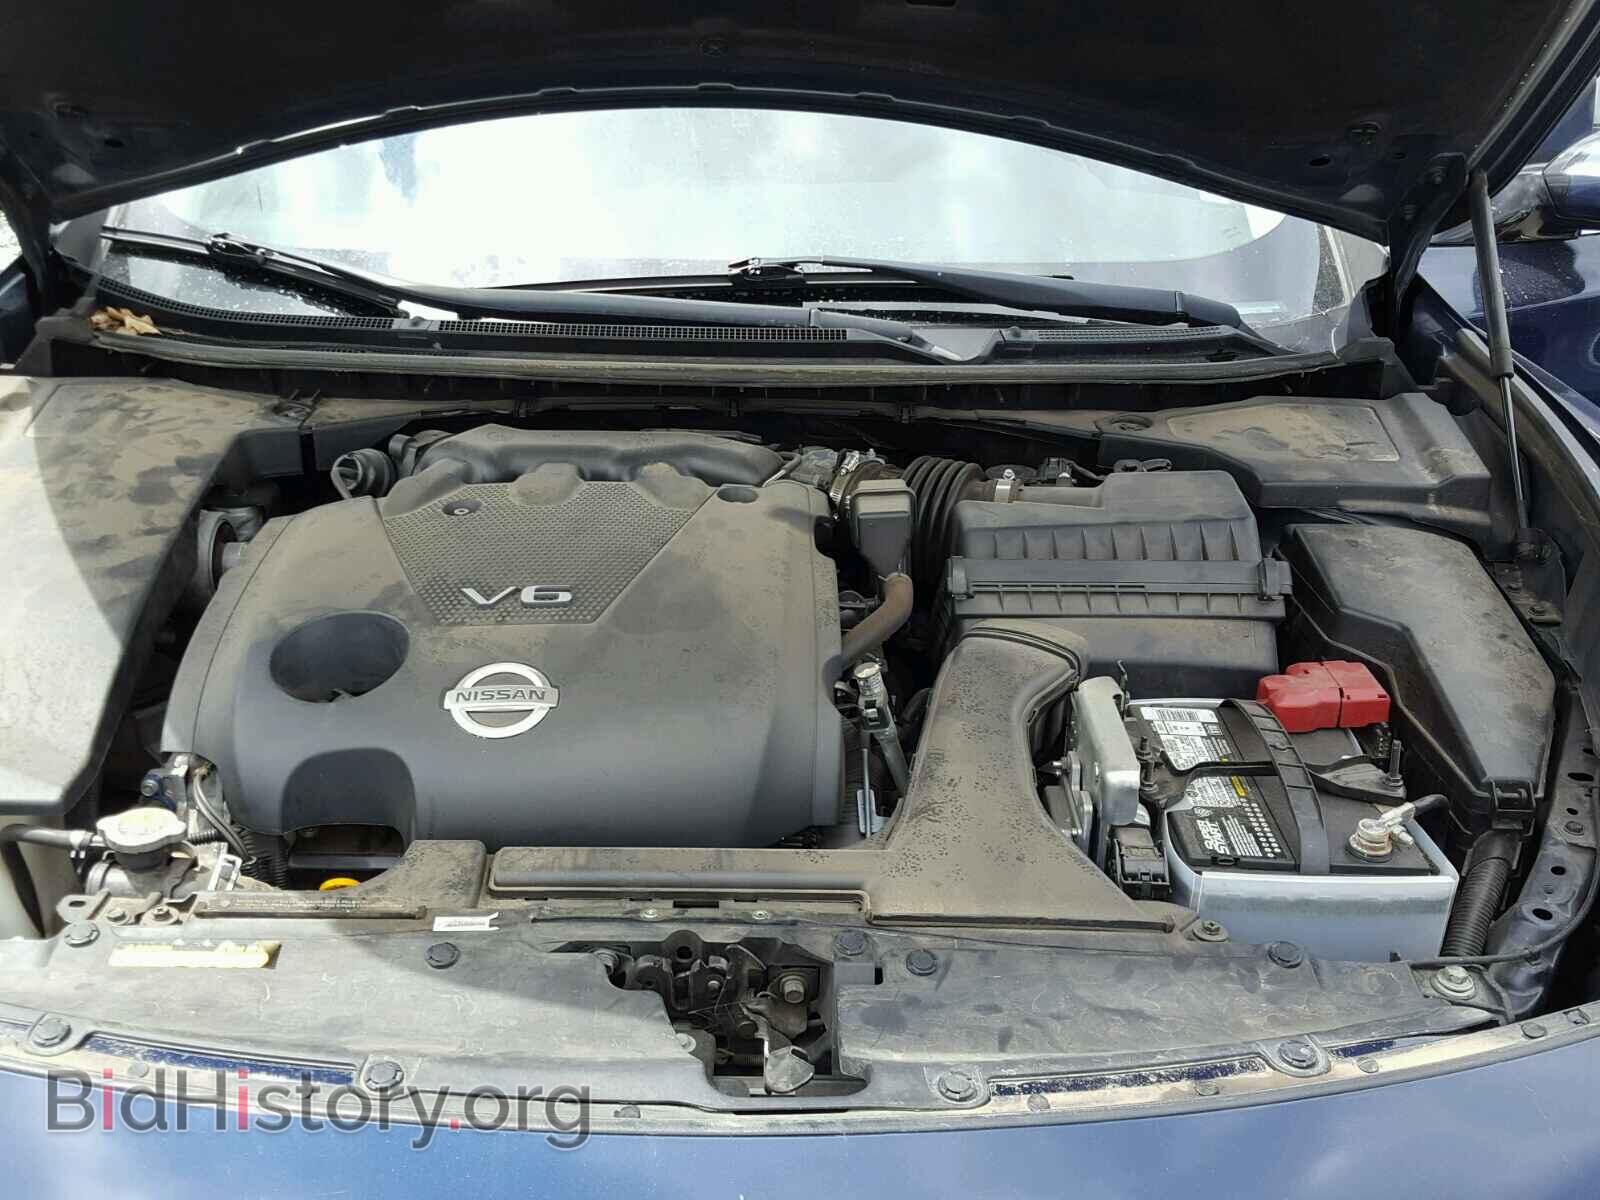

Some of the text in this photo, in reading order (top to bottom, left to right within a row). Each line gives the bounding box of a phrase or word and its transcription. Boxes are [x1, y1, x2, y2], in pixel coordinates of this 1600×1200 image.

[461, 585, 573, 604] V6
[455, 689, 546, 703] NISSAN
[1209, 821, 1226, 854] START
